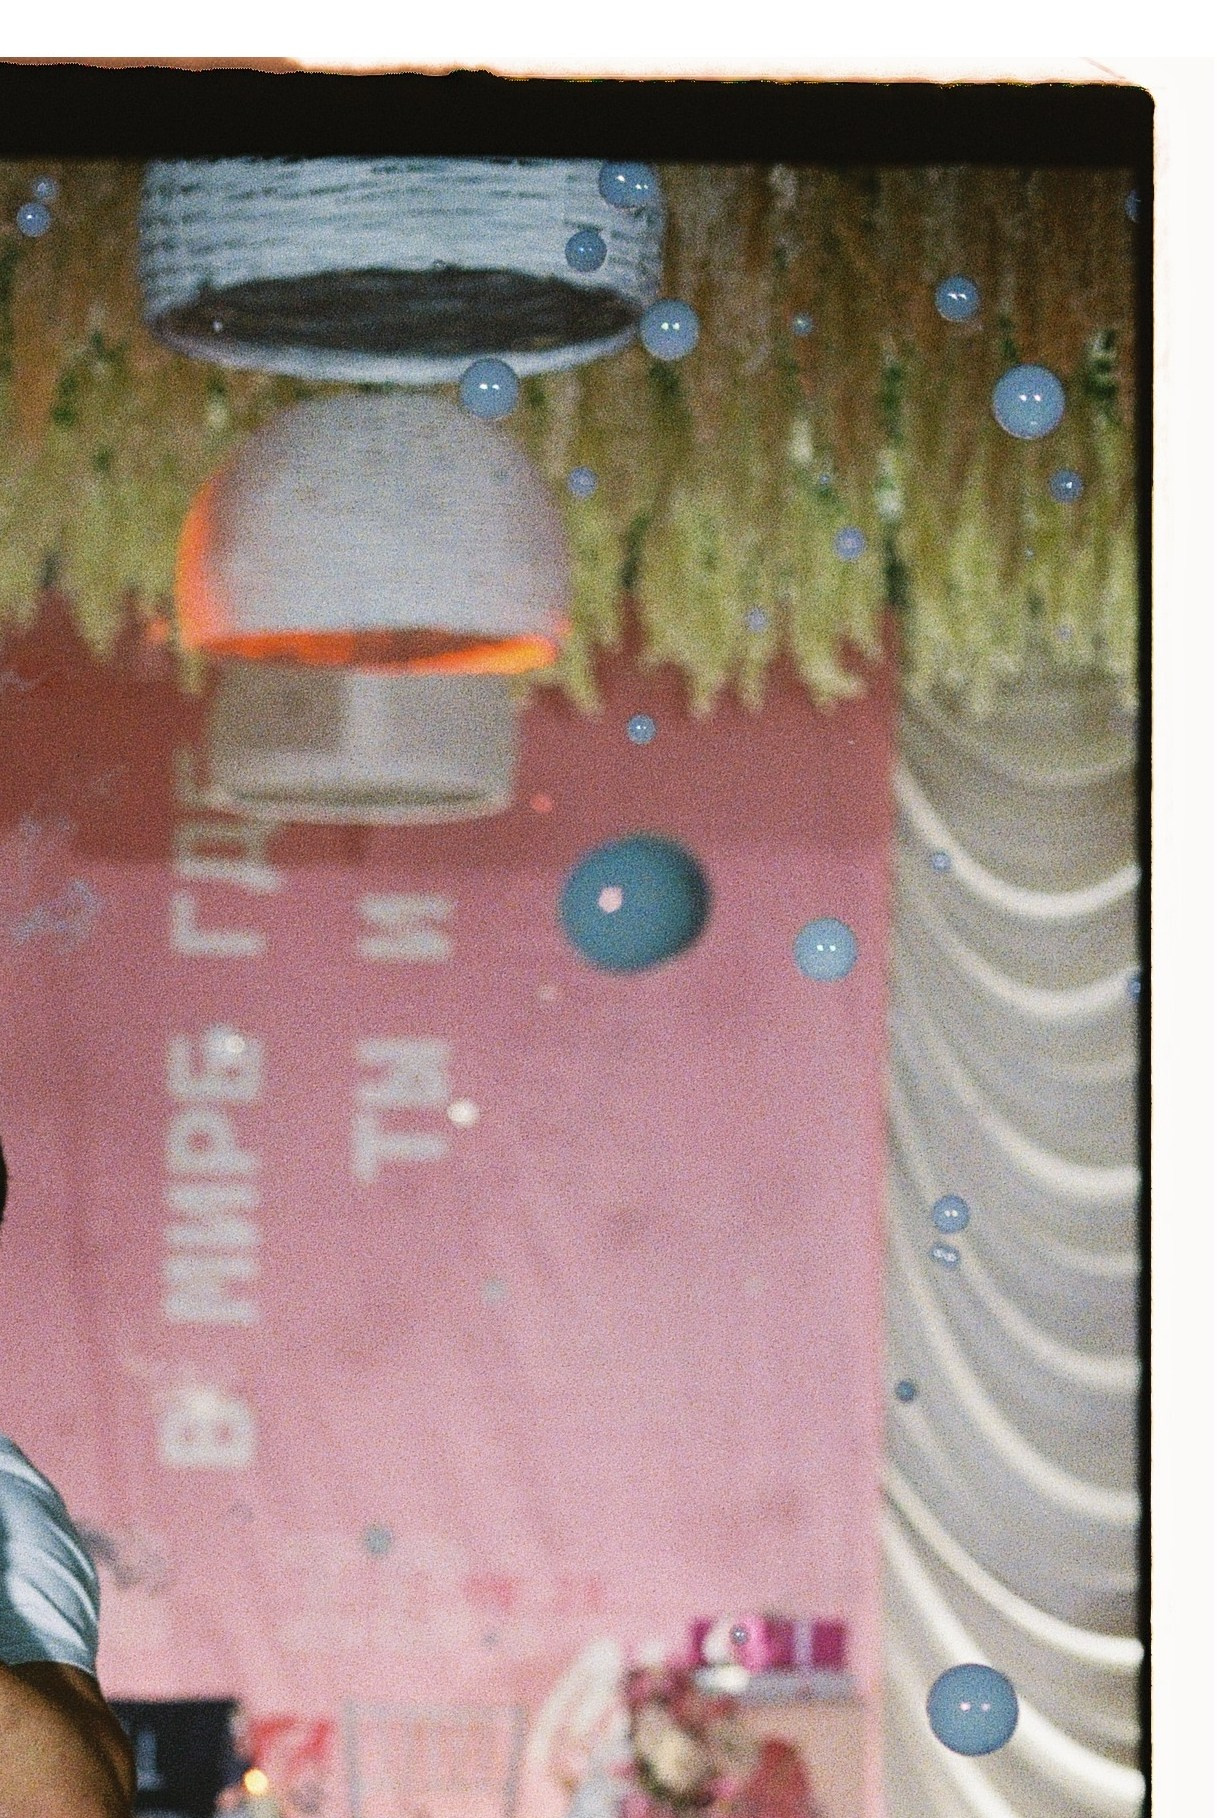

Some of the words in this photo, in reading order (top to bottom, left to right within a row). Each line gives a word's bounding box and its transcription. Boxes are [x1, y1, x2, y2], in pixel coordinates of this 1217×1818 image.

[356, 893, 456, 962] И
[353, 1037, 453, 1184] ТЫ
[159, 1386, 259, 1470] В
